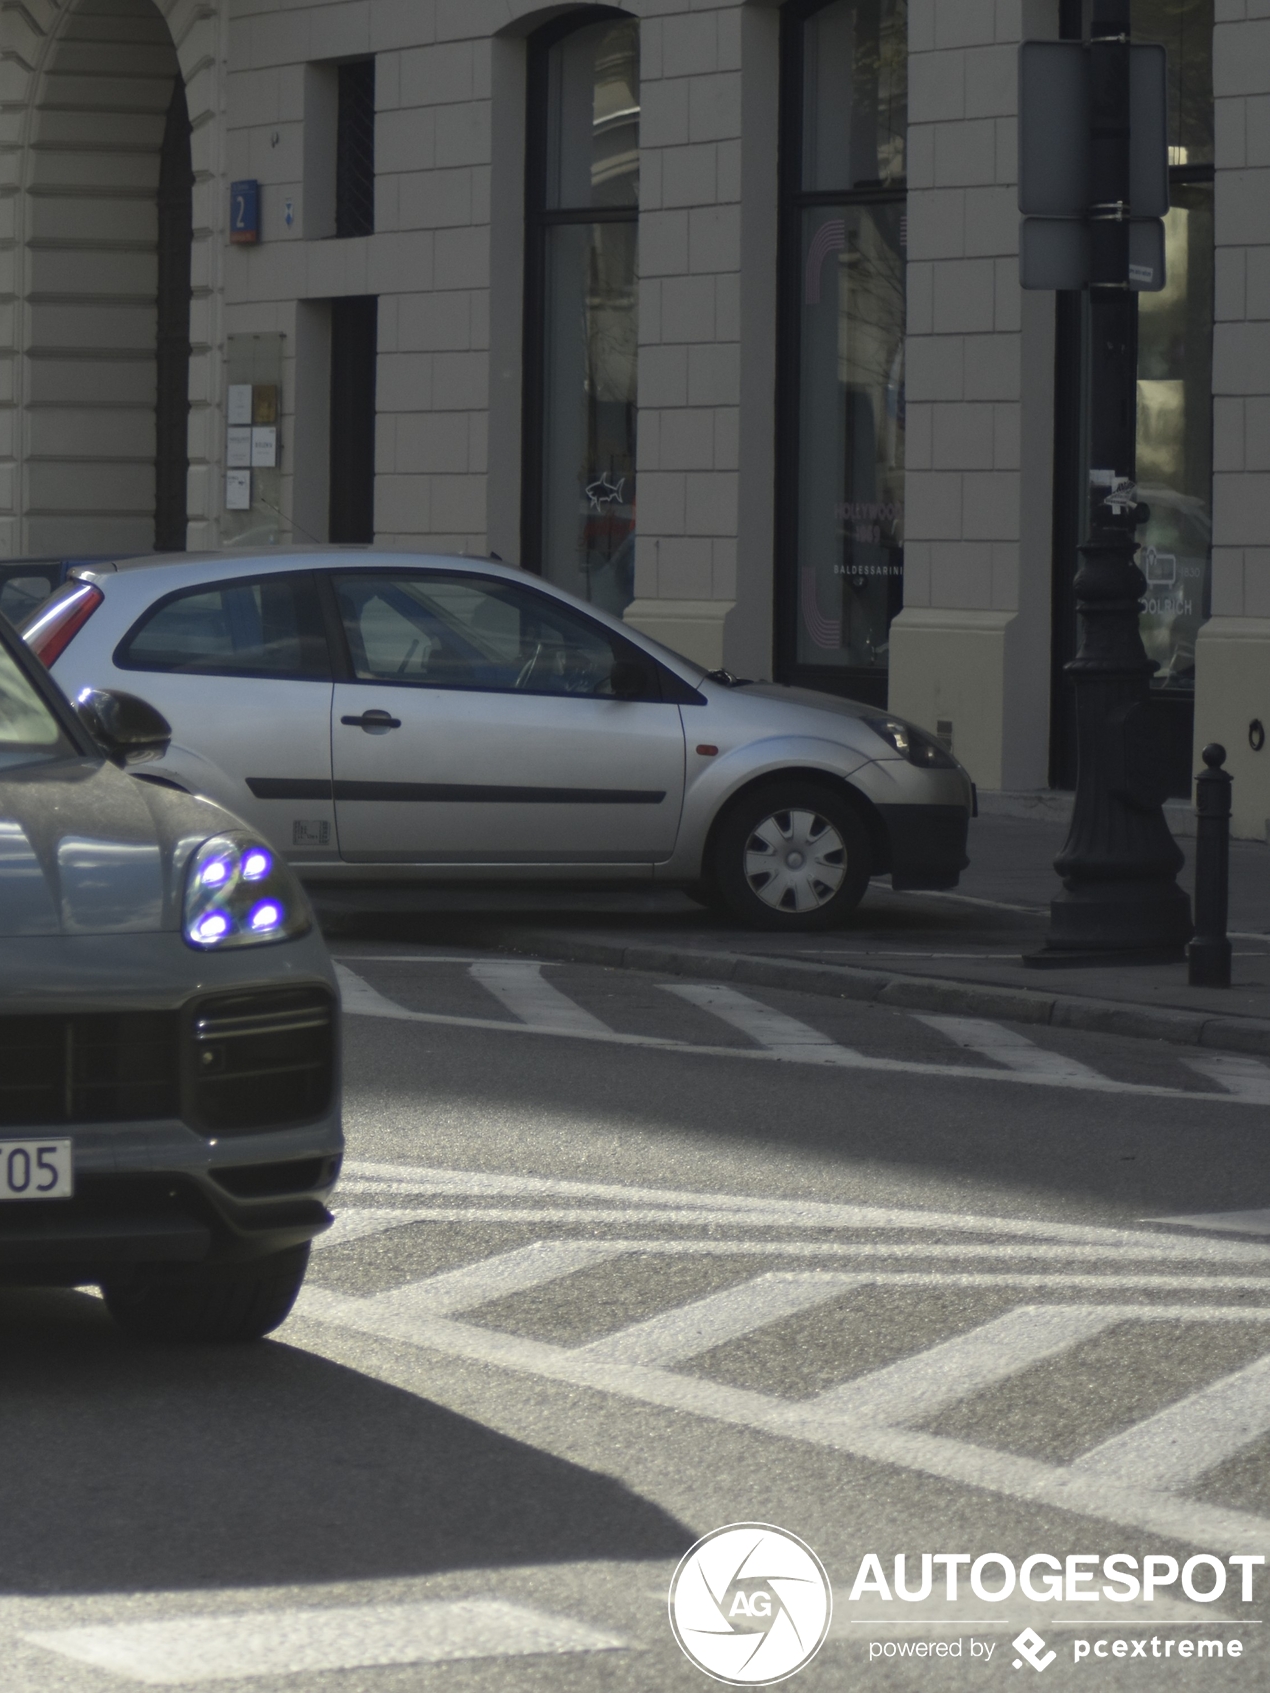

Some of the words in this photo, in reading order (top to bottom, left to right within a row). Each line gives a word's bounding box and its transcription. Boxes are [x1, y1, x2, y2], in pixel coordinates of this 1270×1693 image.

[235, 195, 245, 229] 2
[833, 564, 903, 575] BALDESSARINI
[1180, 567, 1201, 578] 1830
[1138, 598, 1192, 615] OOLRICH
